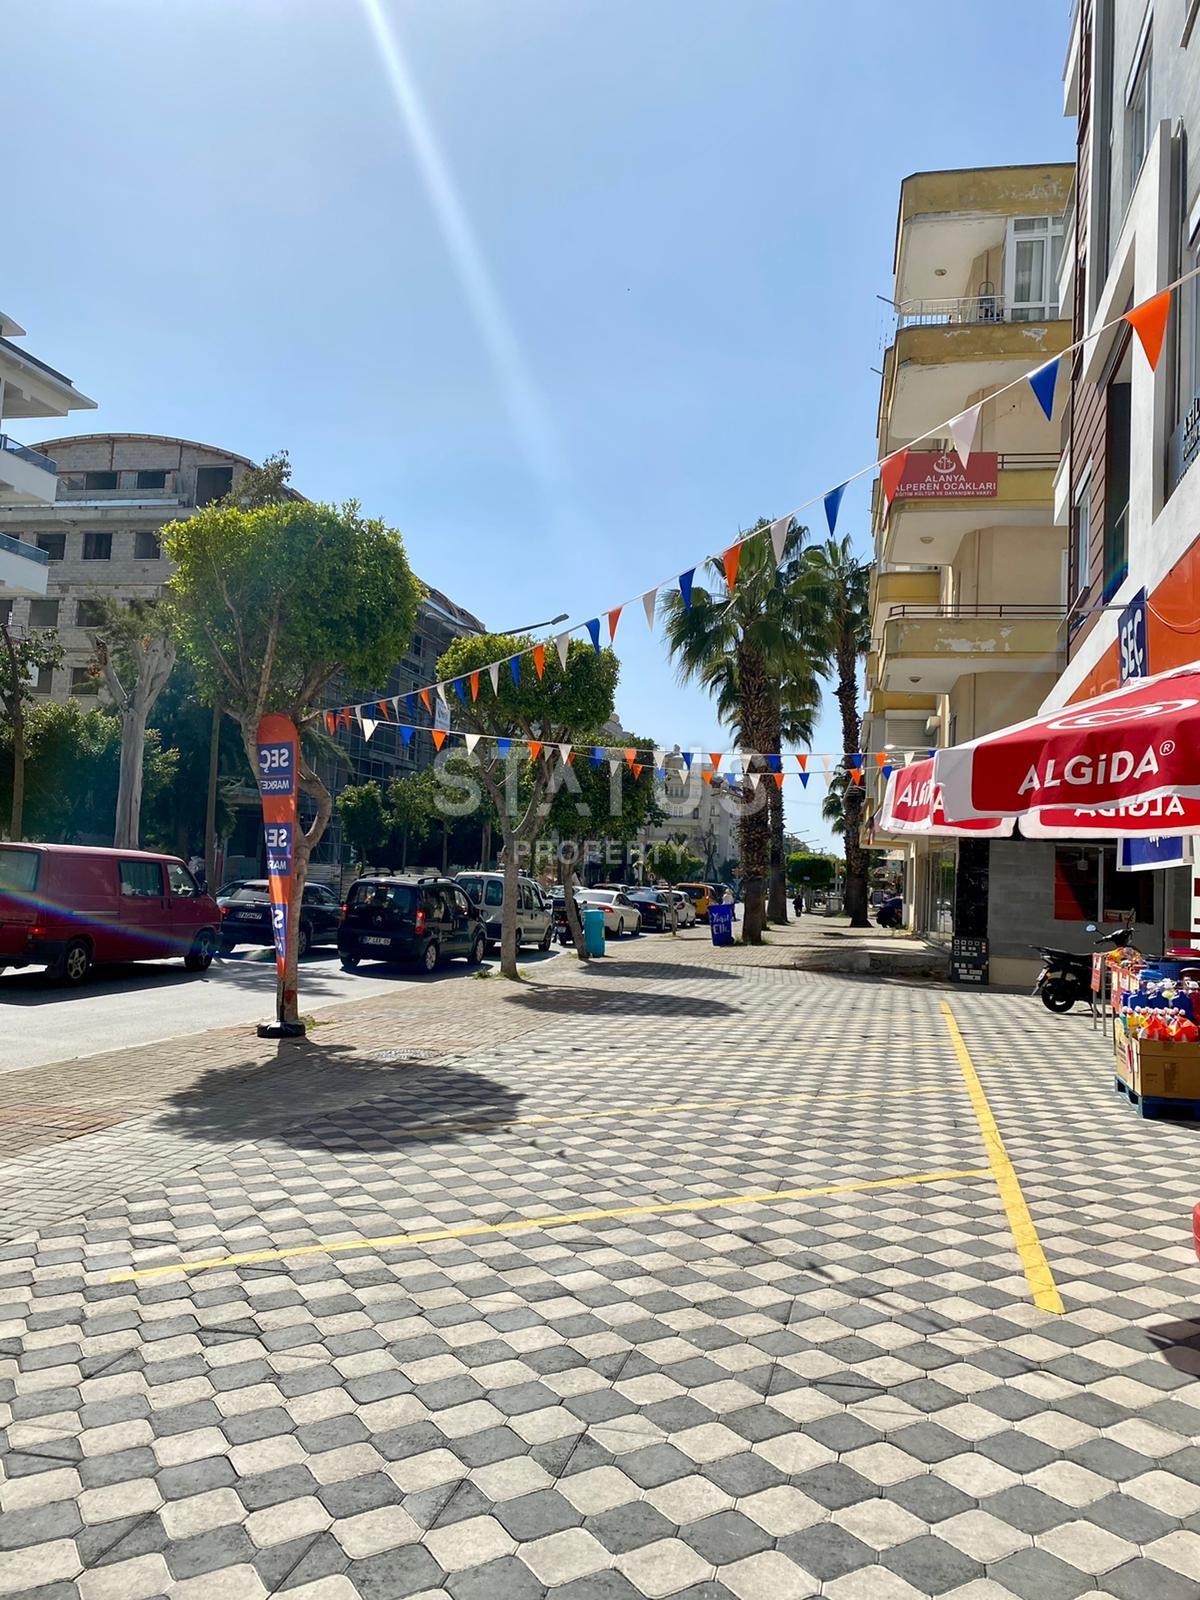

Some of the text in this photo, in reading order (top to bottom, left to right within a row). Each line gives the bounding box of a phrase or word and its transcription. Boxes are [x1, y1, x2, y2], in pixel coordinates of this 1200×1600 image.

[925, 474, 966, 483] ALANYA
[943, 482, 996, 491] OCAKLARI
[1121, 608, 1144, 680] SEÇ
